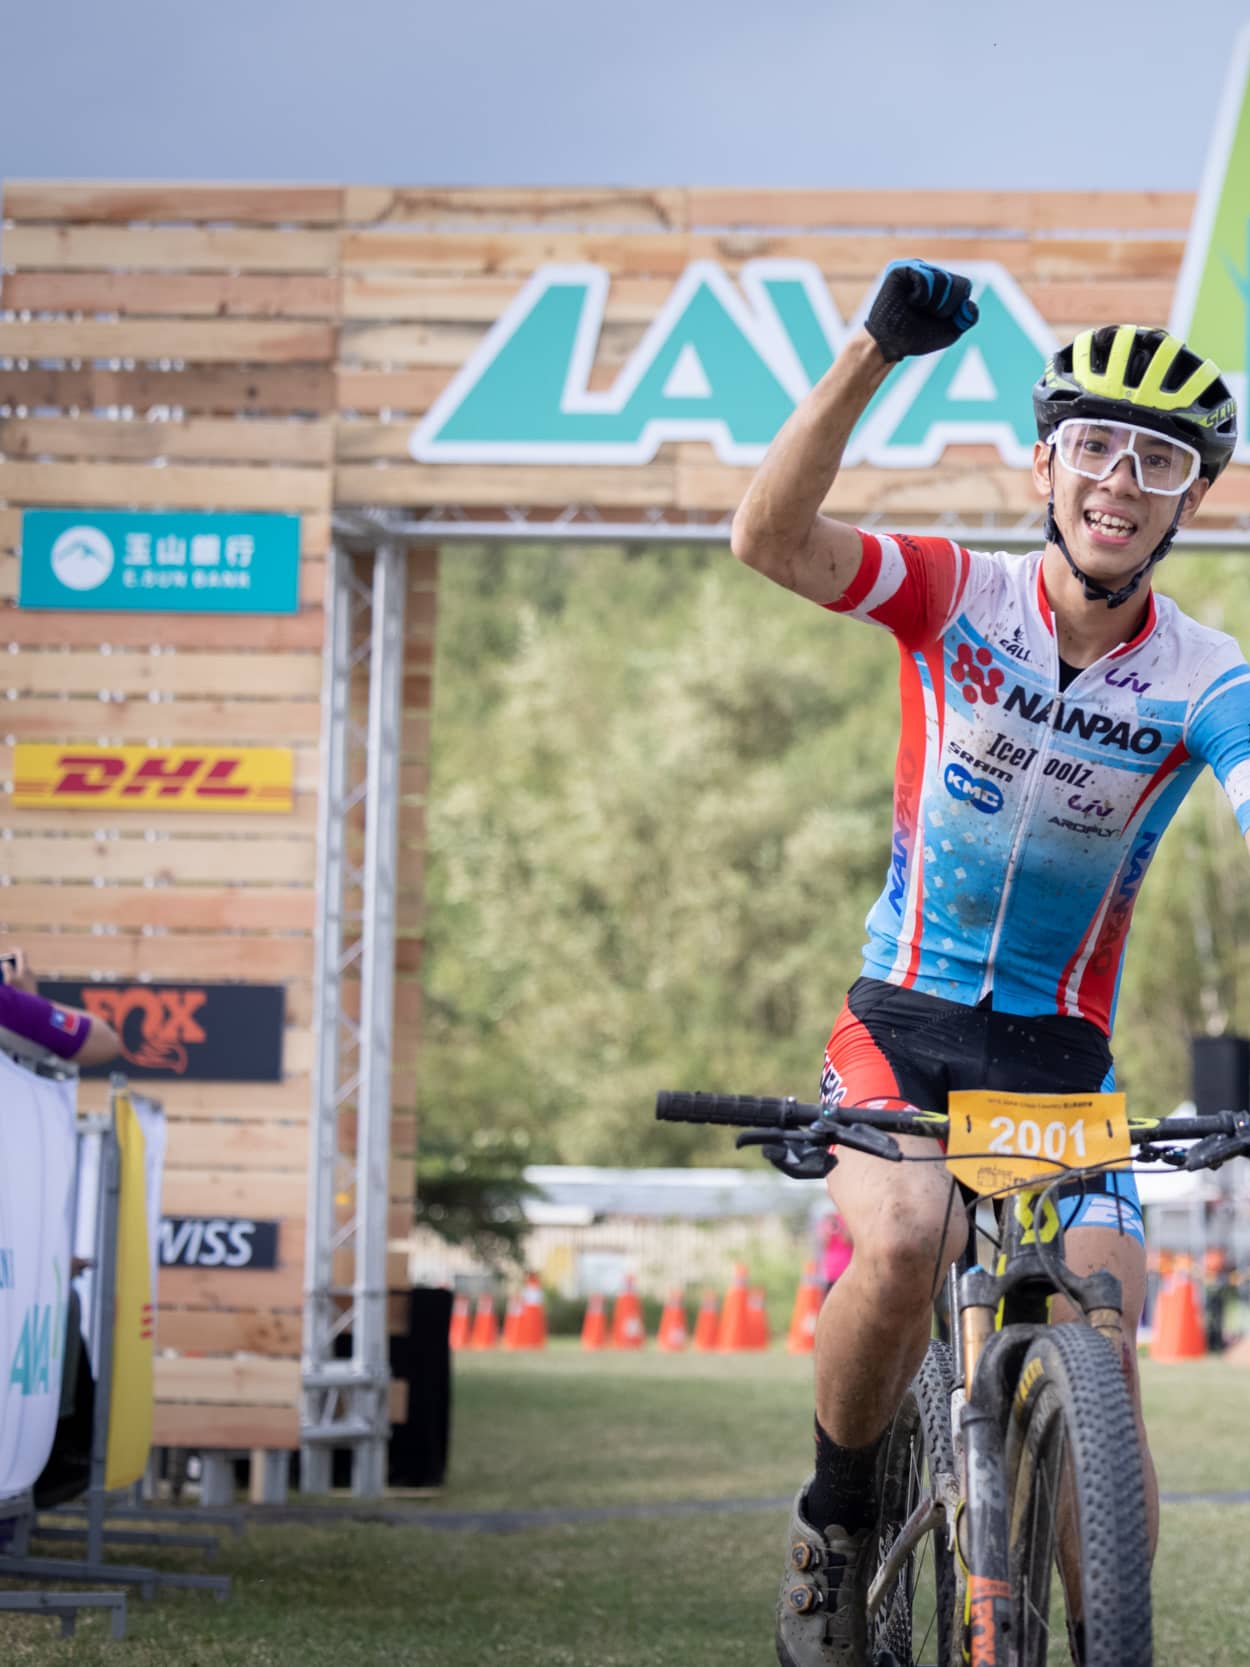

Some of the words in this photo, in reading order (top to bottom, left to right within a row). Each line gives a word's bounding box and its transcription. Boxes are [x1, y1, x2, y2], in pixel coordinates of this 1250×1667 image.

[1105, 667, 1152, 693] Liv
[1003, 685, 1162, 755] NANPAO
[53, 757, 250, 796] DHL
[948, 741, 1013, 783] SRAM
[986, 733, 1093, 789] IceToolz
[947, 770, 1000, 808] KMC
[1067, 794, 1115, 817] Liv
[988, 1115, 1087, 1161] 2001
